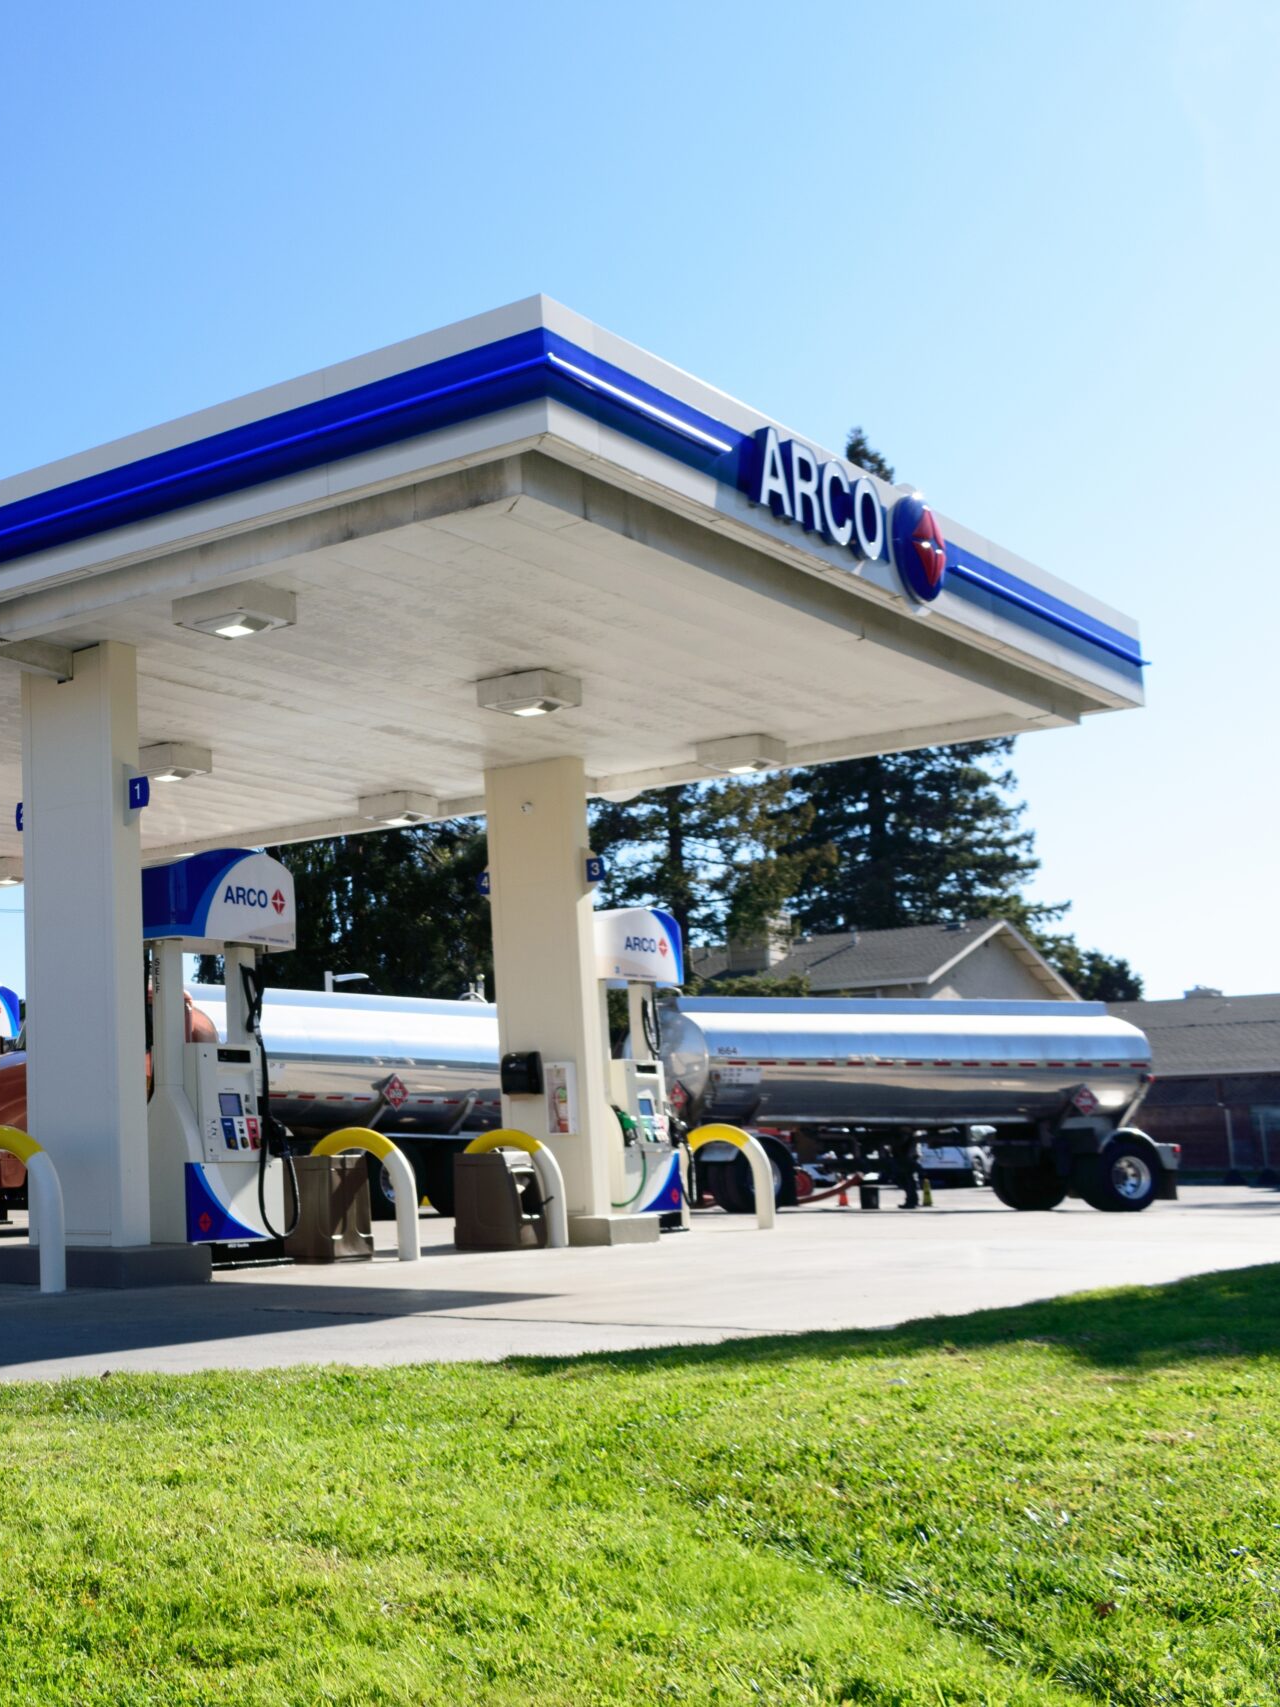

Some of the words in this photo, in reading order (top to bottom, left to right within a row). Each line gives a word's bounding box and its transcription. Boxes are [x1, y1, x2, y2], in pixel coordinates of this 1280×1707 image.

[759, 426, 884, 560] ARCO
[134, 783, 140, 800] 1
[591, 862, 600, 876] 3
[223, 885, 268, 909] ARCO
[624, 936, 657, 953] ARCO
